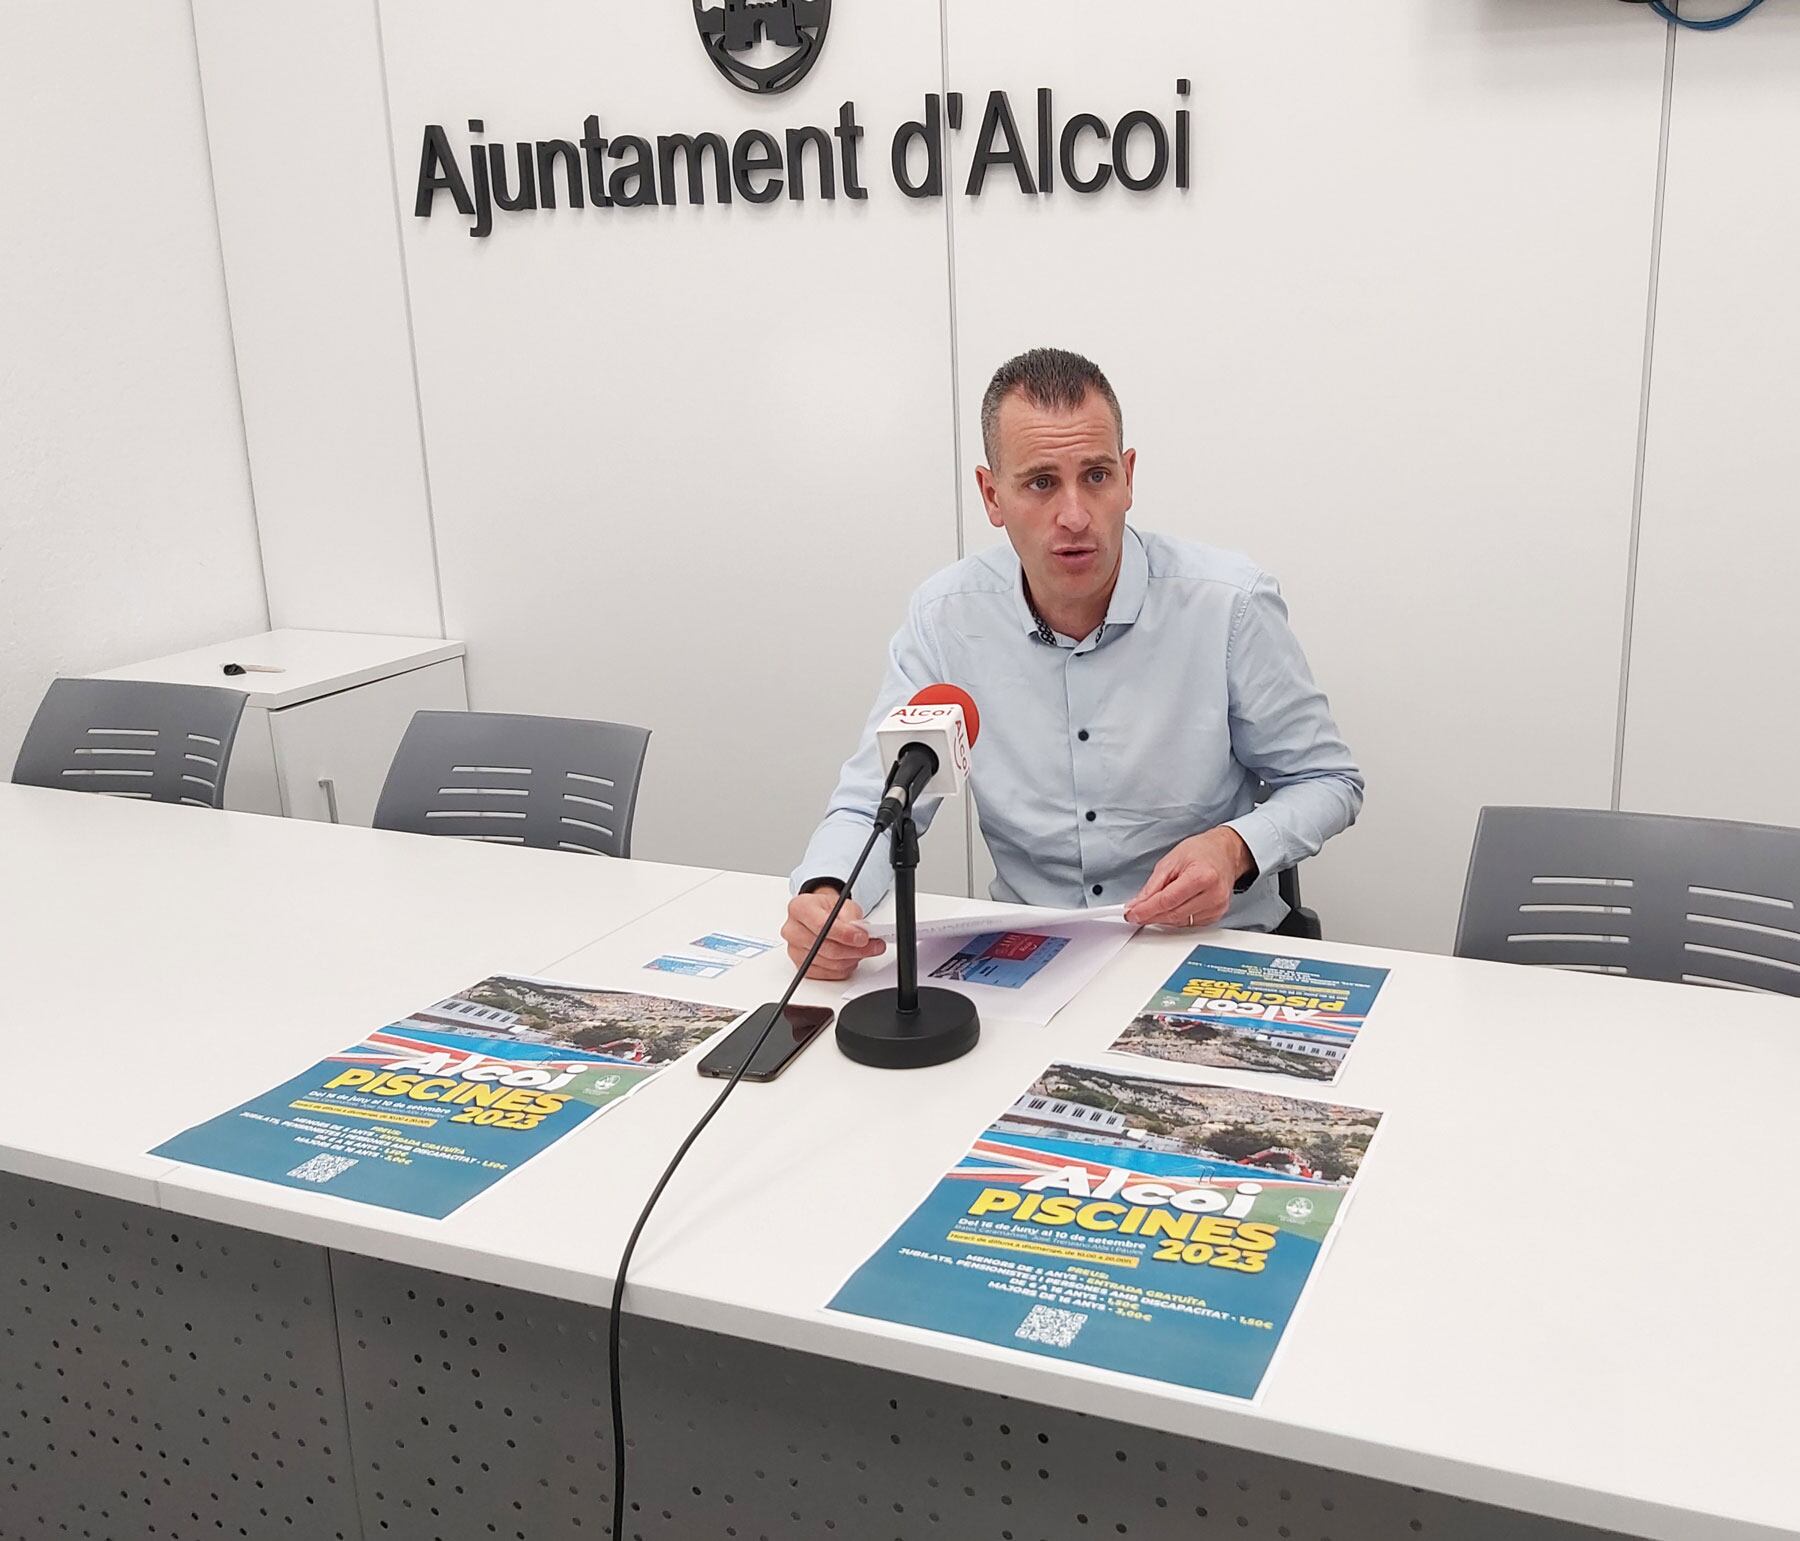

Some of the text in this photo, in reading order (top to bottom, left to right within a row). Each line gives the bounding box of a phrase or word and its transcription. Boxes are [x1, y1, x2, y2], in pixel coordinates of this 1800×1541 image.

[414, 78, 1192, 238] Ajuntament d'Alcoi
[890, 707, 954, 717] Alcoi
[955, 720, 970, 777] Alcoi
[1181, 986, 1345, 1012] PISCINES
[1187, 998, 1320, 1020] Alcoi
[380, 1052, 590, 1090] Alcoi
[323, 1068, 575, 1115] PISCINES
[449, 1105, 548, 1132] 2023
[1020, 1165, 1263, 1221] Alcoi
[958, 1218, 979, 1227] Del
[981, 1220, 994, 1229] 16
[995, 1223, 1010, 1231] de
[1011, 1224, 1039, 1236] juny
[1055, 1231, 1068, 1240] 10
[1070, 1233, 1086, 1242] de
[1087, 1237, 1146, 1250] setembre
[967, 1187, 1281, 1253] PISCINES
[966, 1254, 1015, 1270] MENORS
[1016, 1263, 1034, 1274] DE
[1044, 1268, 1079, 1281] ANYS
[1086, 1278, 1144, 1296] ENTRADA
[1067, 1266, 1110, 1280] PREUS:
[1153, 1237, 1269, 1276] 2023
[956, 1258, 1038, 1282] PENSIONISTES
[1045, 1277, 1108, 1295] PERSONES
[1109, 1290, 1140, 1303] AMB
[1140, 1296, 1230, 1321] DISCAPACITAT
[987, 1280, 1038, 1297] MAJORS
[1038, 1290, 1057, 1300] DE
[1072, 1296, 1107, 1312] ANYS
[1009, 1277, 1028, 1288] DE
[1064, 1287, 1099, 1301] ANYS
